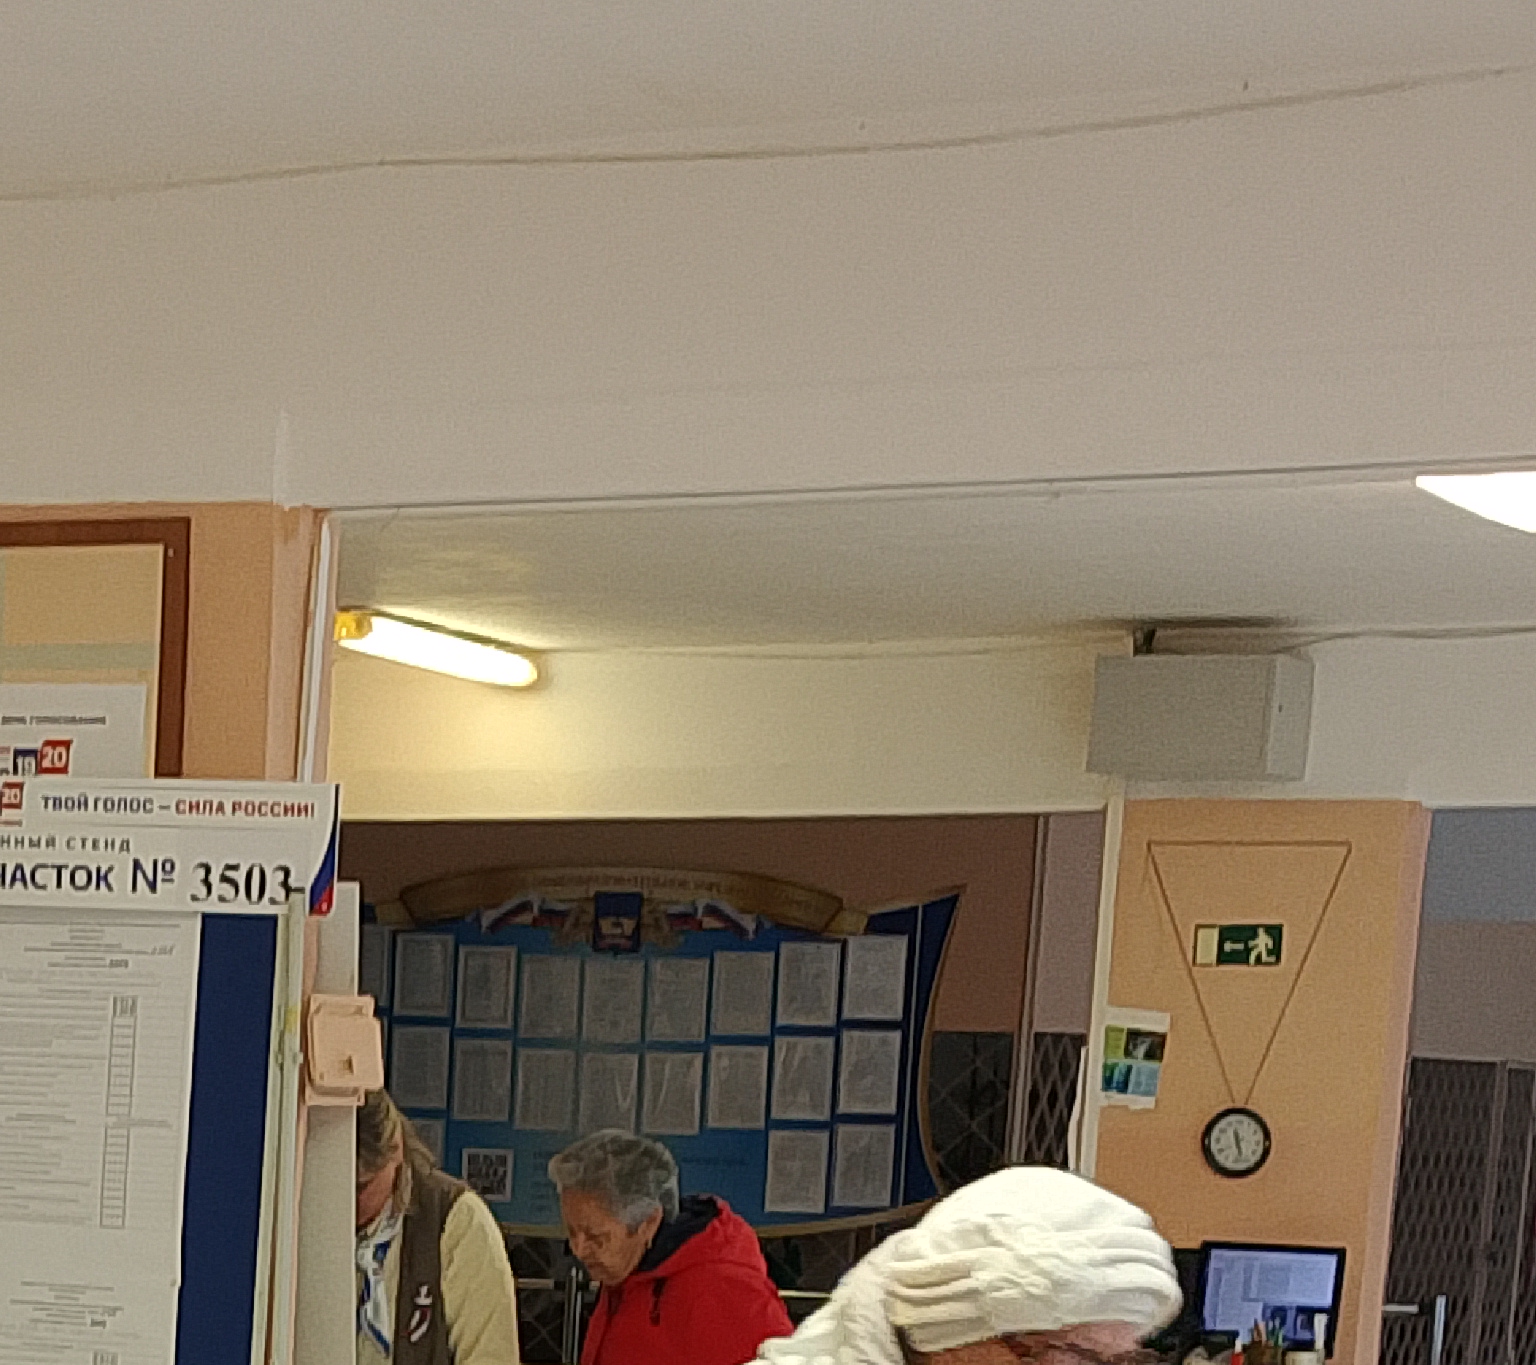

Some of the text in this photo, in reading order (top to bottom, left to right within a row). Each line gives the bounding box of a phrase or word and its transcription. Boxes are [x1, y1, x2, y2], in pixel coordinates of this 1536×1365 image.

[41, 746, 67, 769] 20
[41, 792, 89, 812] ТВОЙ
[93, 795, 155, 814] ГОЛОС
[175, 799, 226, 817] СИЛА
[231, 800, 315, 818] РОССИИ!
[65, 836, 131, 855] СТЕНД
[132, 857, 176, 894] №
[190, 861, 293, 906] 3503
